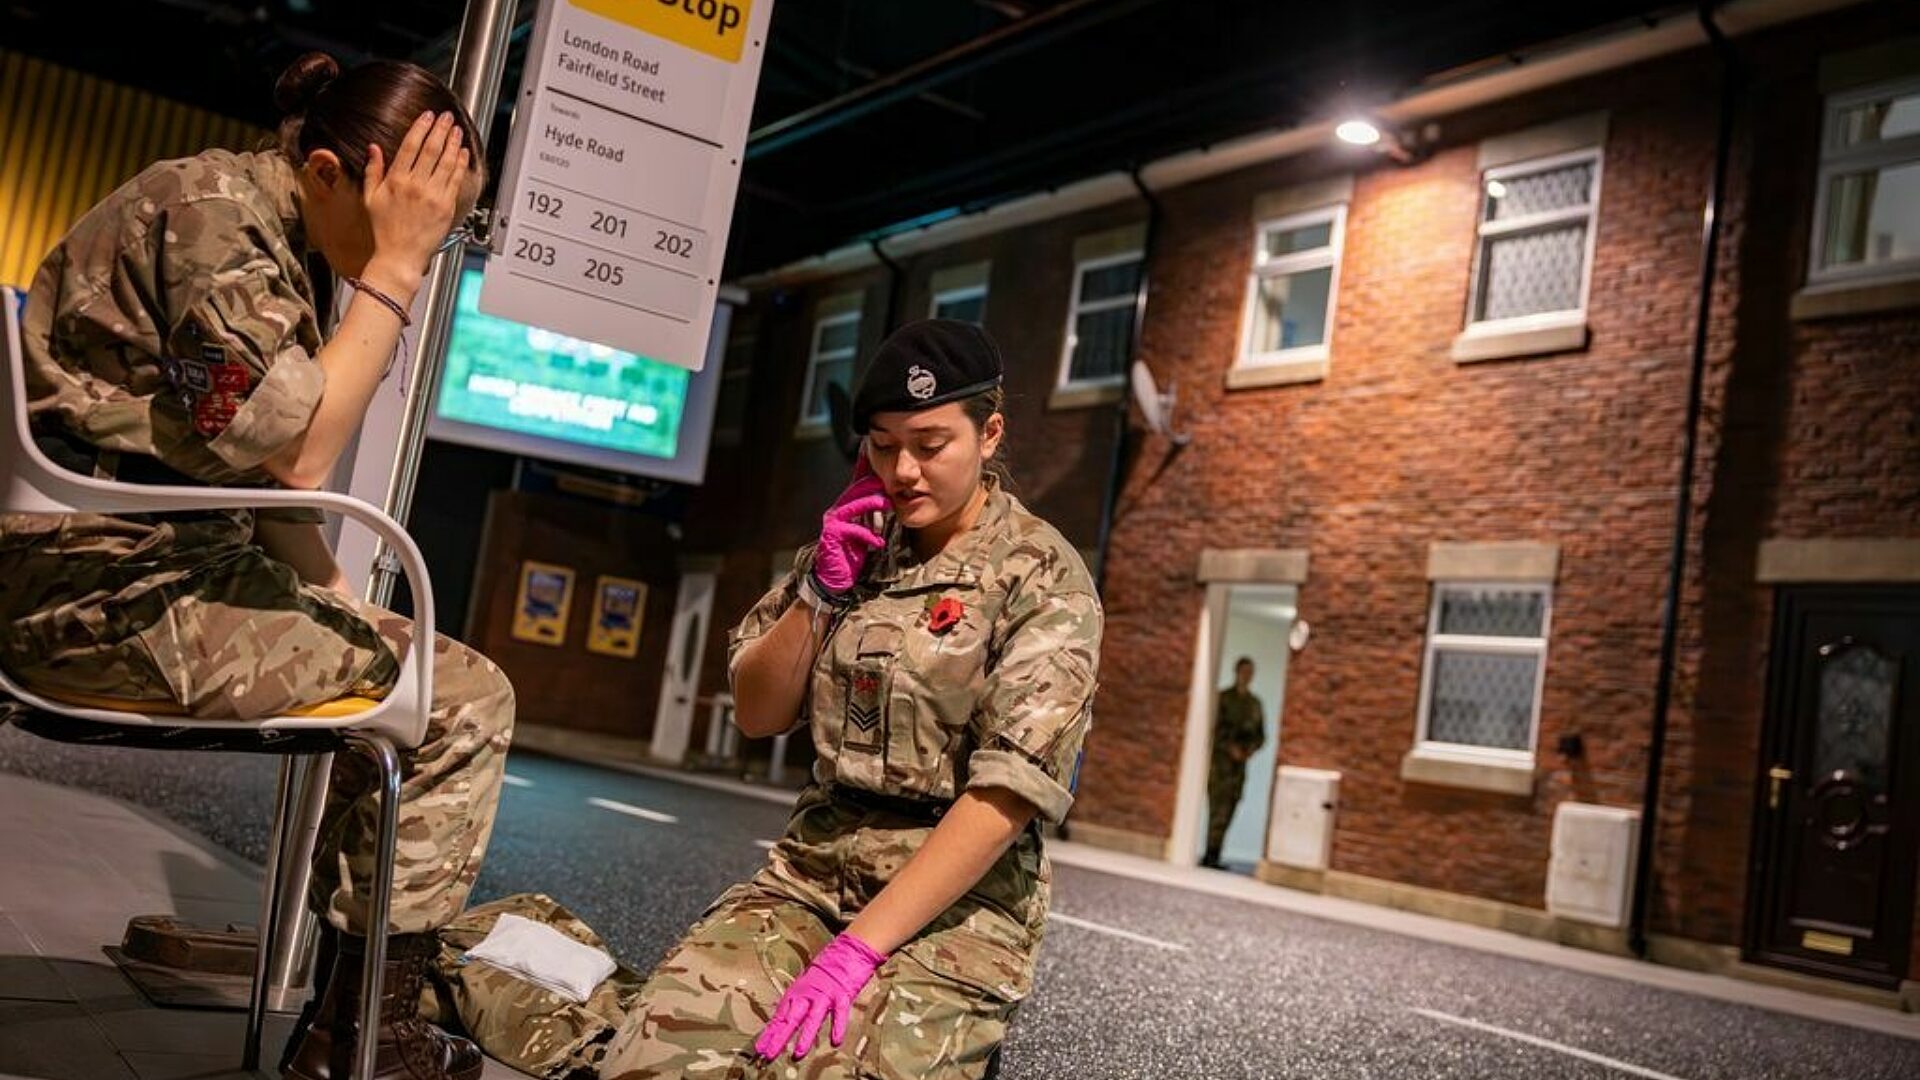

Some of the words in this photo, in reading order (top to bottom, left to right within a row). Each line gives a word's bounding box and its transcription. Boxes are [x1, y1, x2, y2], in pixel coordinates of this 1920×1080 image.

[658, 0, 740, 35] top
[563, 29, 619, 62] London
[622, 49, 660, 76] Road
[558, 52, 618, 87] Fairfield
[621, 75, 665, 103] Street
[544, 123, 584, 150] Hyde
[586, 138, 624, 163] Road
[526, 191, 564, 219] 192
[590, 211, 627, 239] 201
[654, 230, 693, 259] 202
[514, 238, 556, 267] 203
[584, 258, 624, 286] 205
